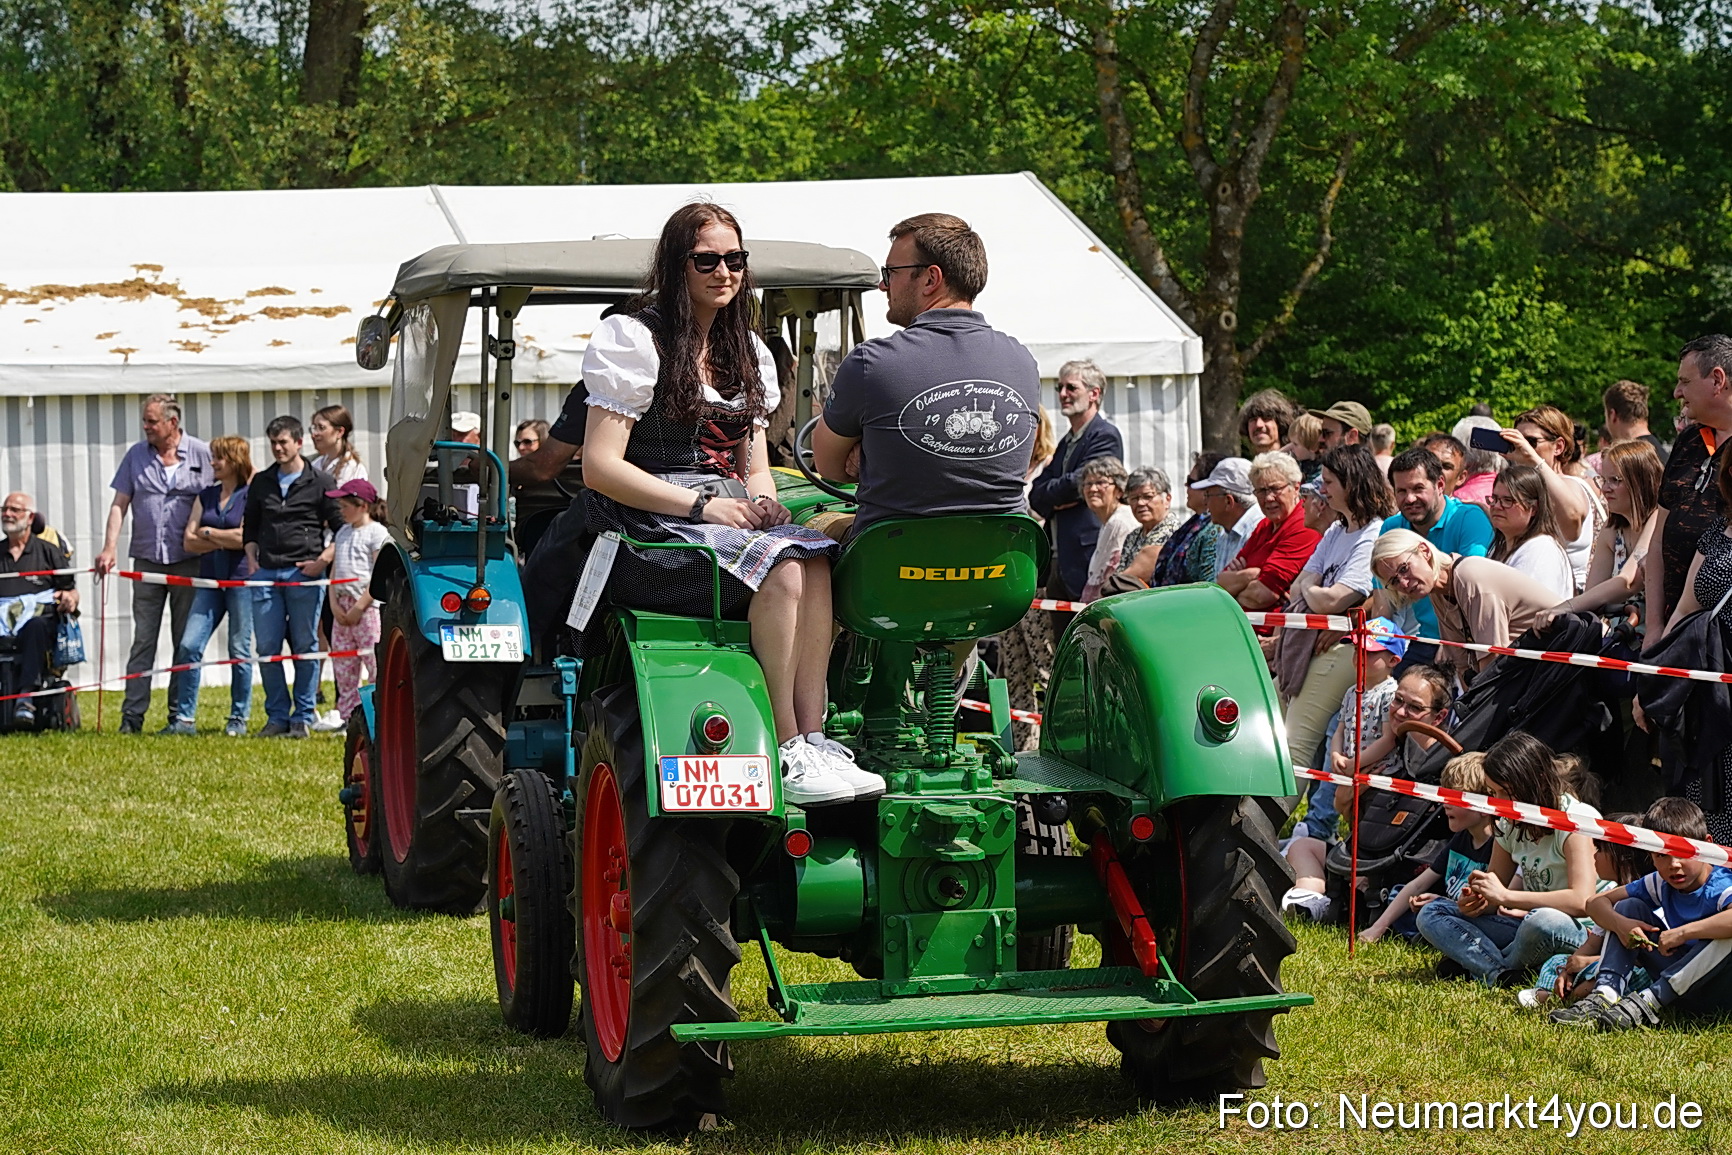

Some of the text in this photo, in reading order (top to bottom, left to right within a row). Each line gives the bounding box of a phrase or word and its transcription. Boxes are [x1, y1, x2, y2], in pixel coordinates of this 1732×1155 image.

[915, 389, 960, 411] Oldtimer
[963, 384, 1004, 397] Freunde
[924, 413, 1020, 426] 19 97
[920, 433, 976, 454] Batzhausen
[899, 564, 1006, 580] DEUTZ
[459, 627, 483, 642] NM
[451, 643, 501, 659] D 217
[667, 772, 675, 780] D
[683, 760, 720, 782] NM
[676, 784, 760, 807] 07031
